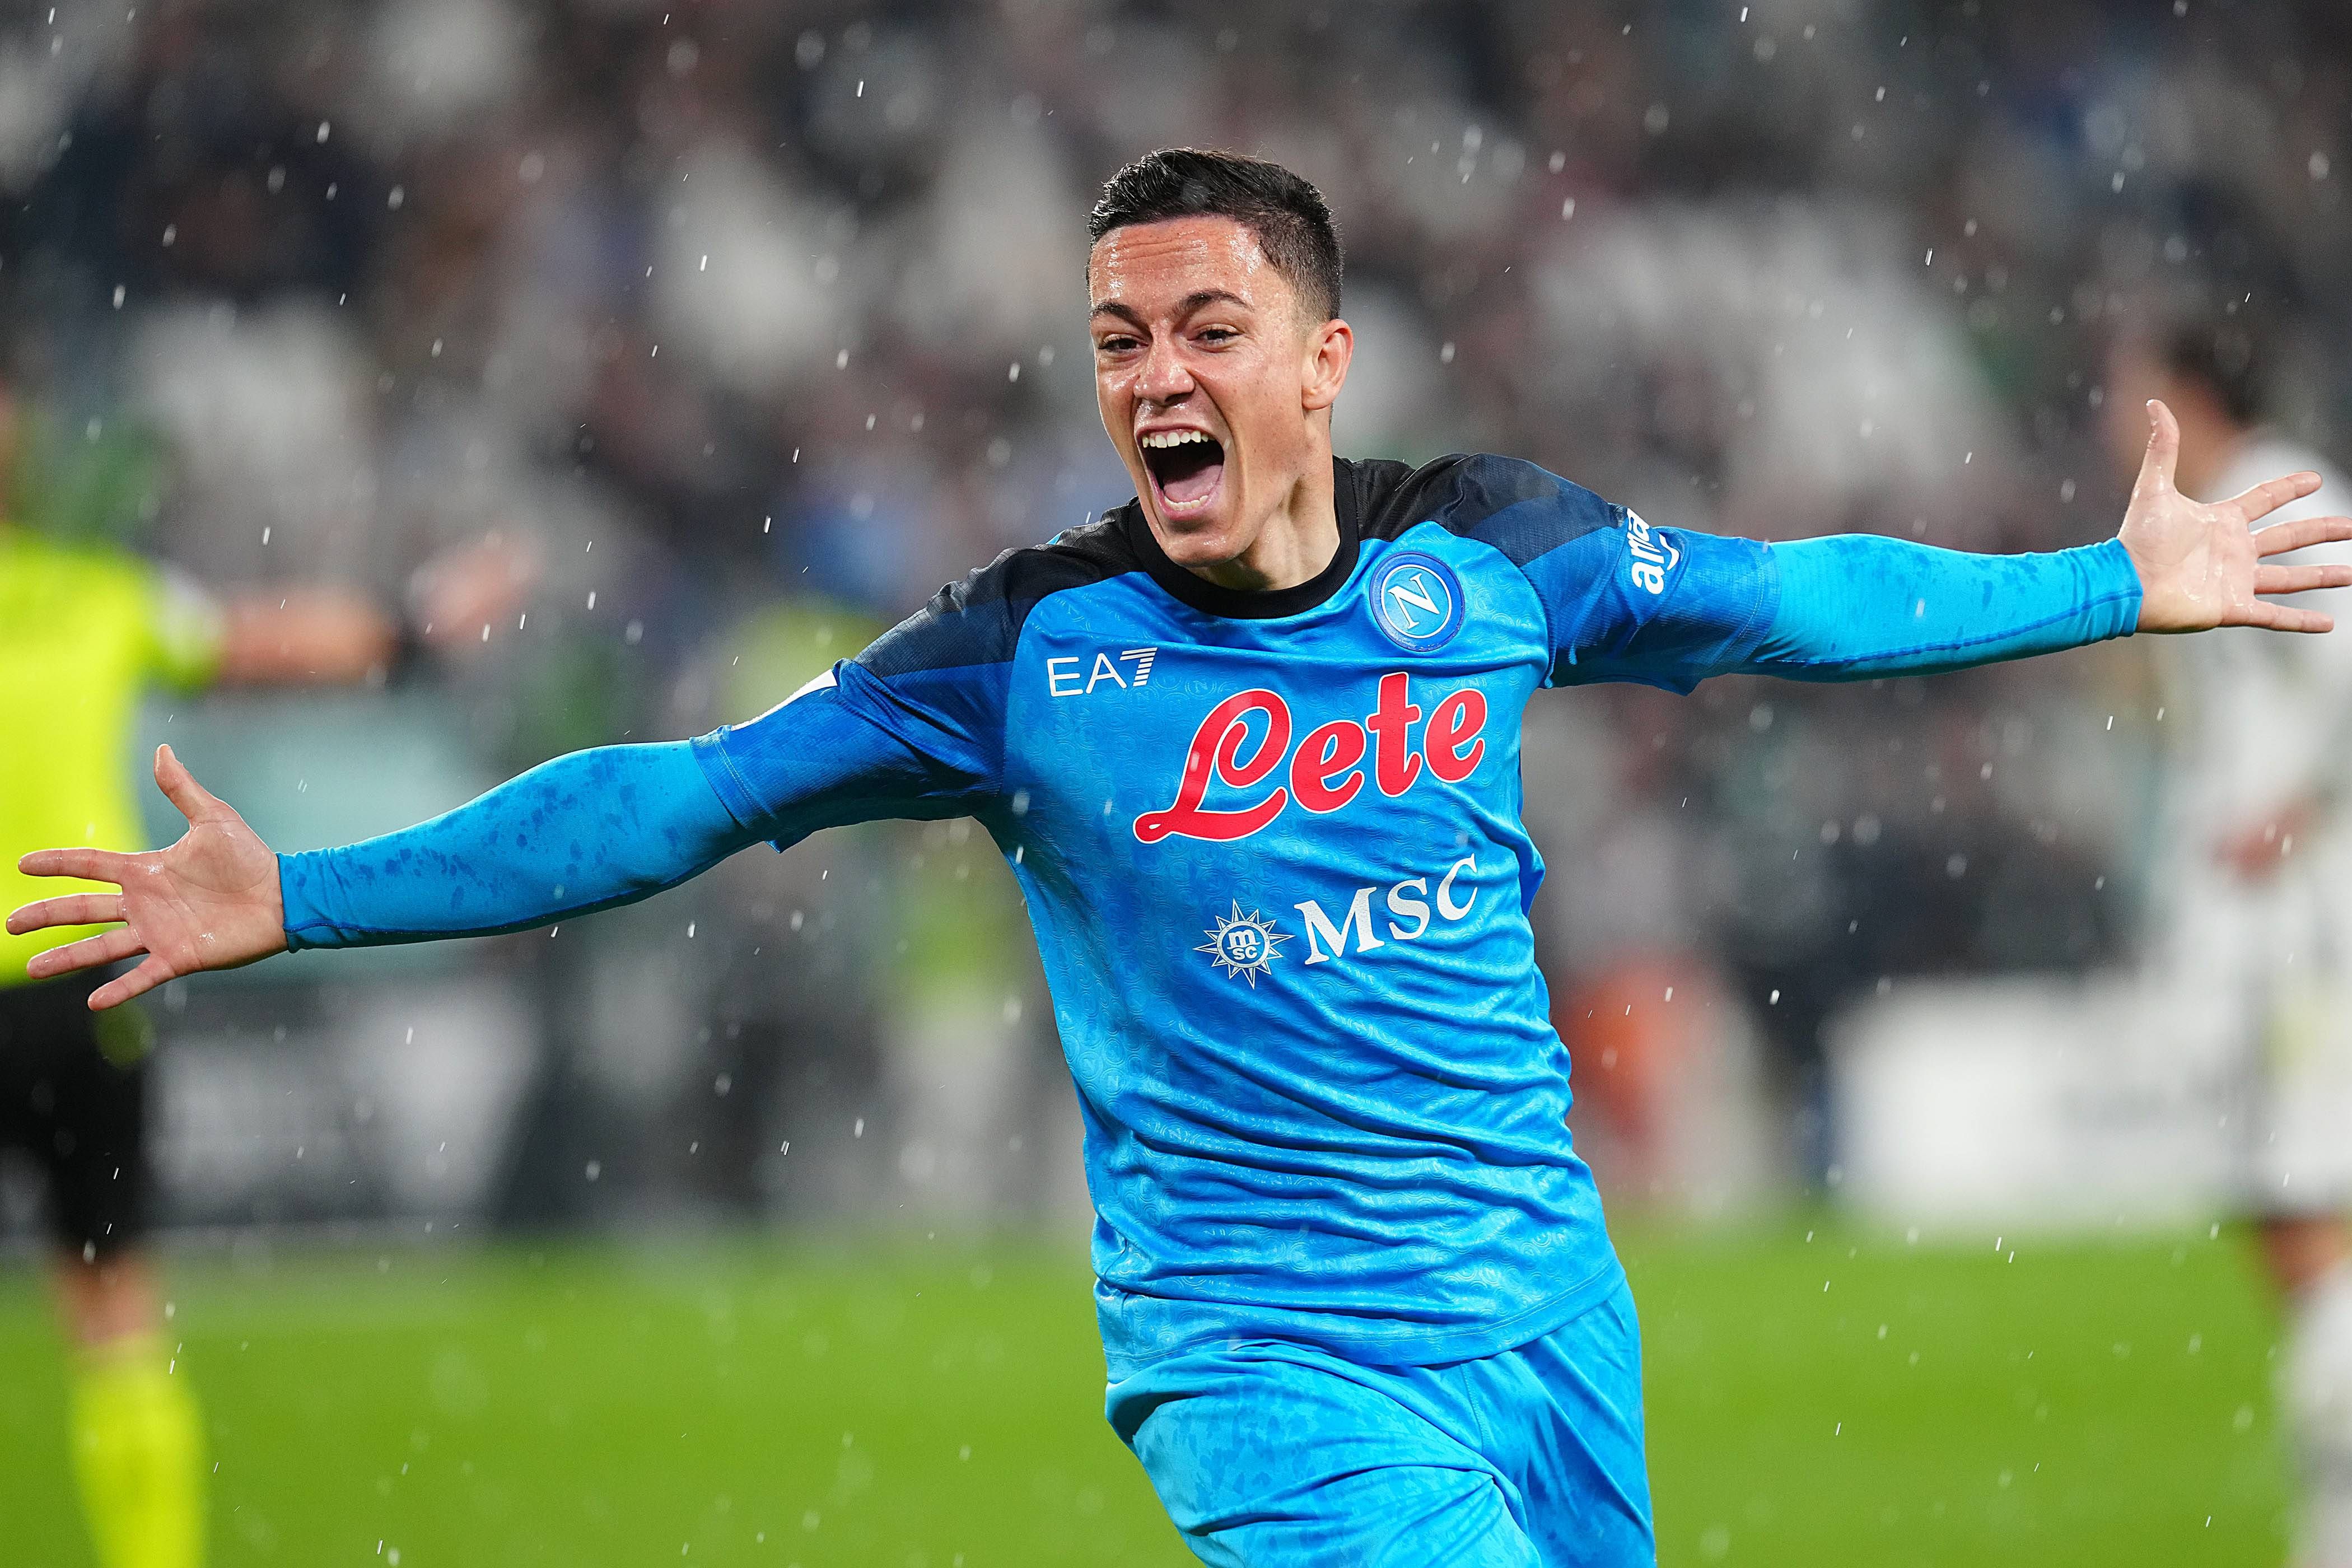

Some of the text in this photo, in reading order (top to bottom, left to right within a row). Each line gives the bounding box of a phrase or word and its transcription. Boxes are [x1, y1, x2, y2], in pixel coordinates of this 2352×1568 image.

[1626, 507, 1665, 595] ama
[1387, 573, 1440, 629] N
[1047, 647, 1158, 697] EA7
[1132, 671, 1488, 844] Lete
[1293, 852, 1478, 965] MSC
